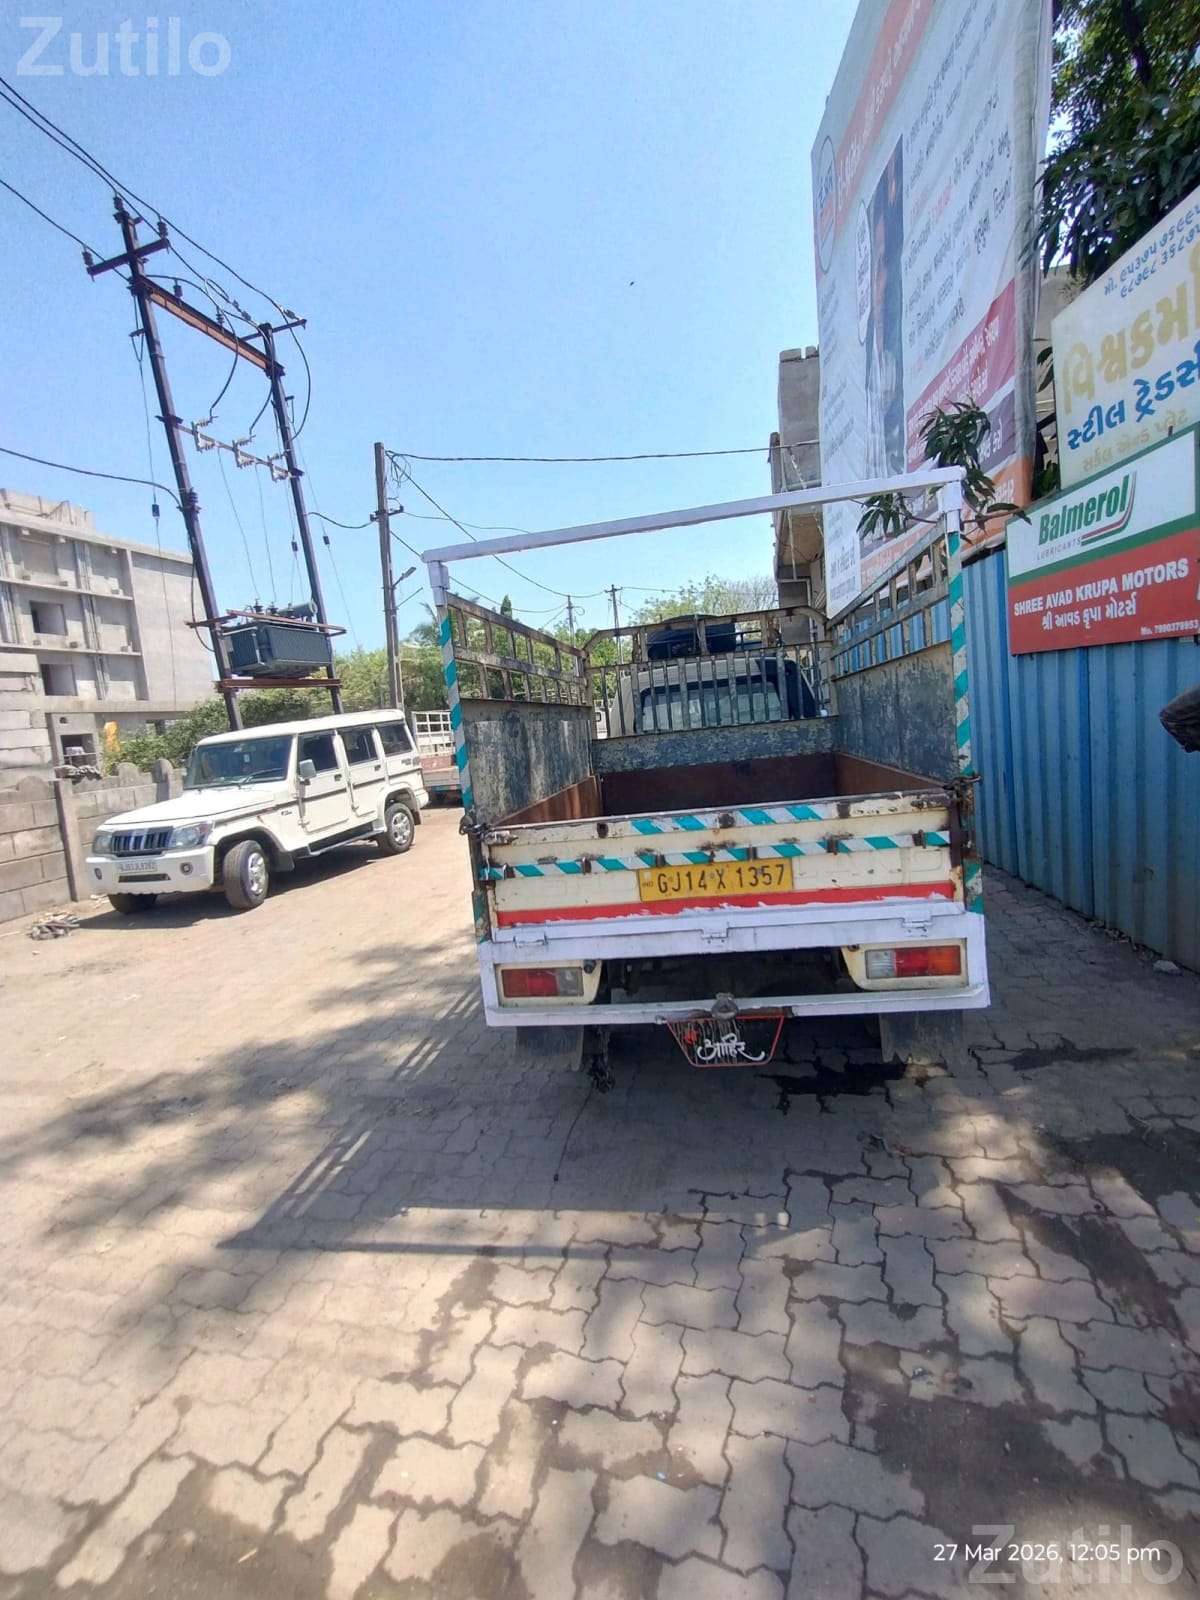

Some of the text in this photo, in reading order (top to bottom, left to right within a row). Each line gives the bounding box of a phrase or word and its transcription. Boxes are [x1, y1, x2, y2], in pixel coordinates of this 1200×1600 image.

[1067, 399, 1126, 451] સ્ટીલ
[1038, 474, 1130, 546] Balmerol
[1036, 536, 1082, 561] LUBRICANTS
[1013, 557, 1190, 616] SHREE AVAD KRUPA MOTORS
[1042, 611, 1053, 630] શ્રી
[1054, 610, 1081, 628] આવડ
[1105, 591, 1138, 619] મોટર્સ
[657, 870, 708, 894] GJ14
[715, 868, 727, 891] X
[736, 863, 785, 889] 1357
